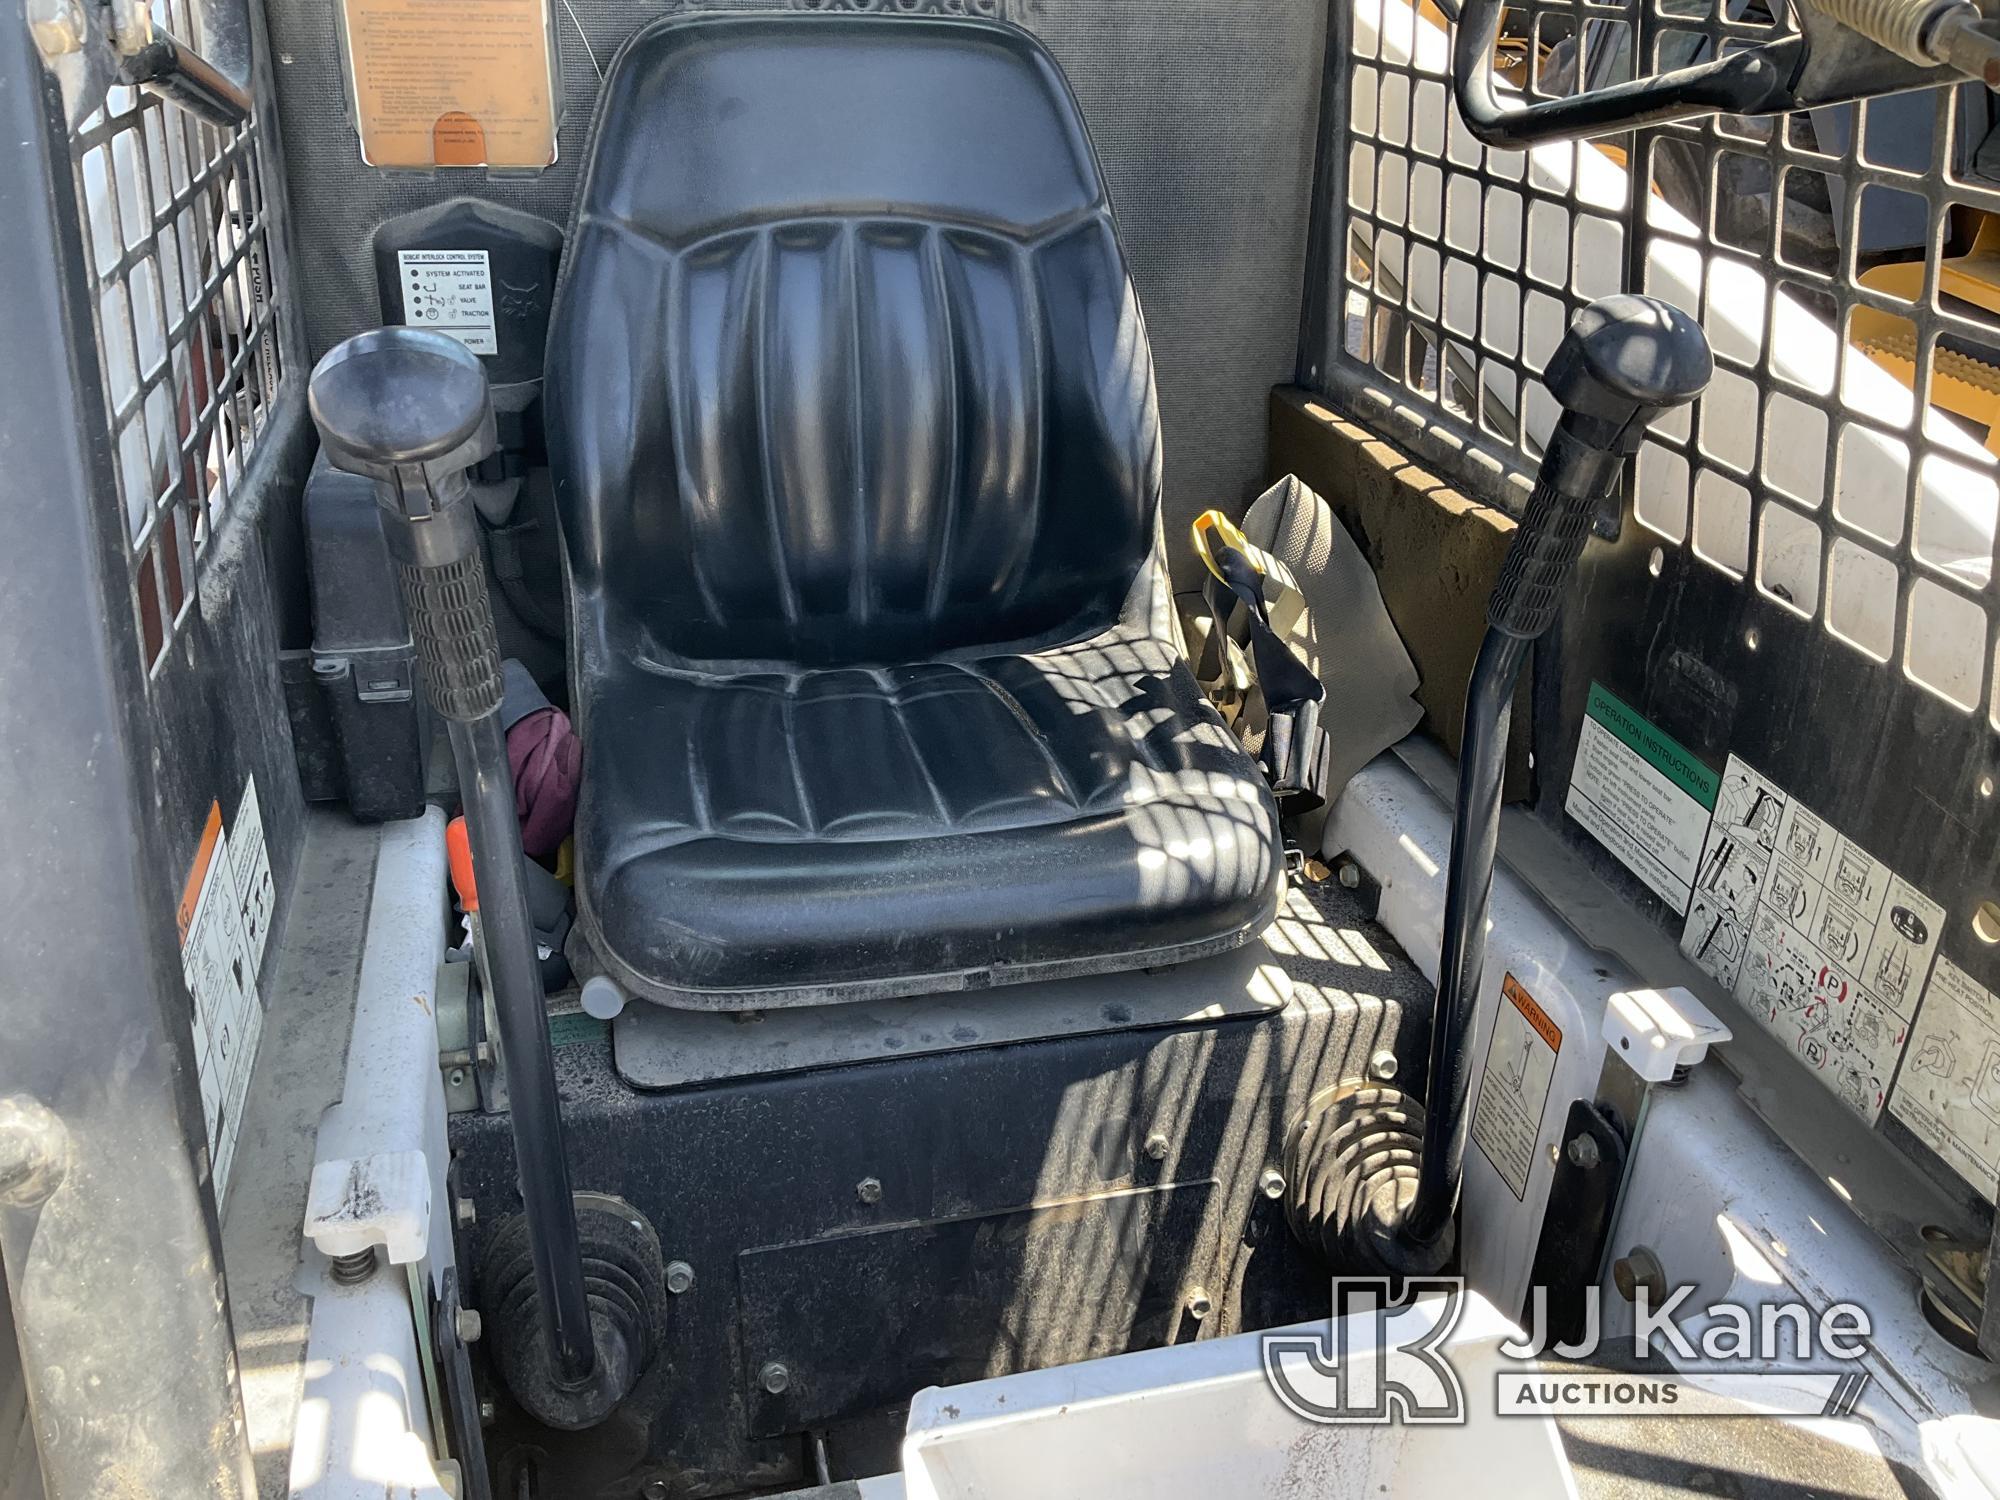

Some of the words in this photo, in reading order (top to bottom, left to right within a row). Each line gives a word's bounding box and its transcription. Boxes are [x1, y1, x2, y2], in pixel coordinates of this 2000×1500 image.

[1590, 720, 1596, 730] TO
[1597, 727, 1619, 748] OPERATE
[1592, 744, 1602, 756] Start
[1594, 697, 1642, 741] OPERATION
[1642, 733, 1709, 793] INSTRUCTIONS
[1590, 753, 1607, 771] Activate
[1608, 769, 1621, 782] green
[1641, 794, 1648, 804] TO
[1593, 735, 1608, 751] Fasten
[1609, 749, 1619, 760] seat
[1619, 757, 1628, 767] belt
[1629, 766, 1638, 776] and
[1638, 772, 1652, 786] lower
[1652, 784, 1663, 796] seat
[1731, 756, 1753, 775] ENTERING
[1754, 773, 1763, 783] THE
[1764, 780, 1782, 798] LOADER
[1586, 770, 1599, 784] NOTE:
[1602, 784, 1619, 802] Activate
[1639, 814, 1646, 826] TO
[1674, 845, 1690, 863] button
[1796, 805, 1821, 826] FORWARD
[1572, 801, 1589, 821] Manual
[1590, 819, 1600, 830] and
[1600, 826, 1625, 854] Handbook
[1634, 859, 1648, 874] more
[1649, 872, 1681, 904] instructions.
[1588, 805, 1598, 818] See
[1598, 814, 1622, 840] Operation
[1623, 836, 1634, 849] and
[1634, 846, 1668, 880] Maintenance
[1844, 840, 1874, 865] BACKWARD
[1778, 856, 1790, 868] LEFT
[1791, 866, 1804, 879] TURN
[1827, 895, 1843, 909] RIGHT
[1845, 908, 1858, 922] TURN
[1935, 971, 1964, 997] PRE-HEAT
[1965, 994, 1994, 1021] POSITION
[1948, 971, 1960, 984] KEY
[1961, 981, 1985, 1003] SWITCH
[1516, 992, 1556, 1043] WARNING
[1520, 1117, 1534, 1136] DEATH
[1902, 1096, 1913, 1109] SEE
[1913, 1107, 1946, 1139] OPERATION
[1952, 1141, 1995, 1182] MAINTENANCE
